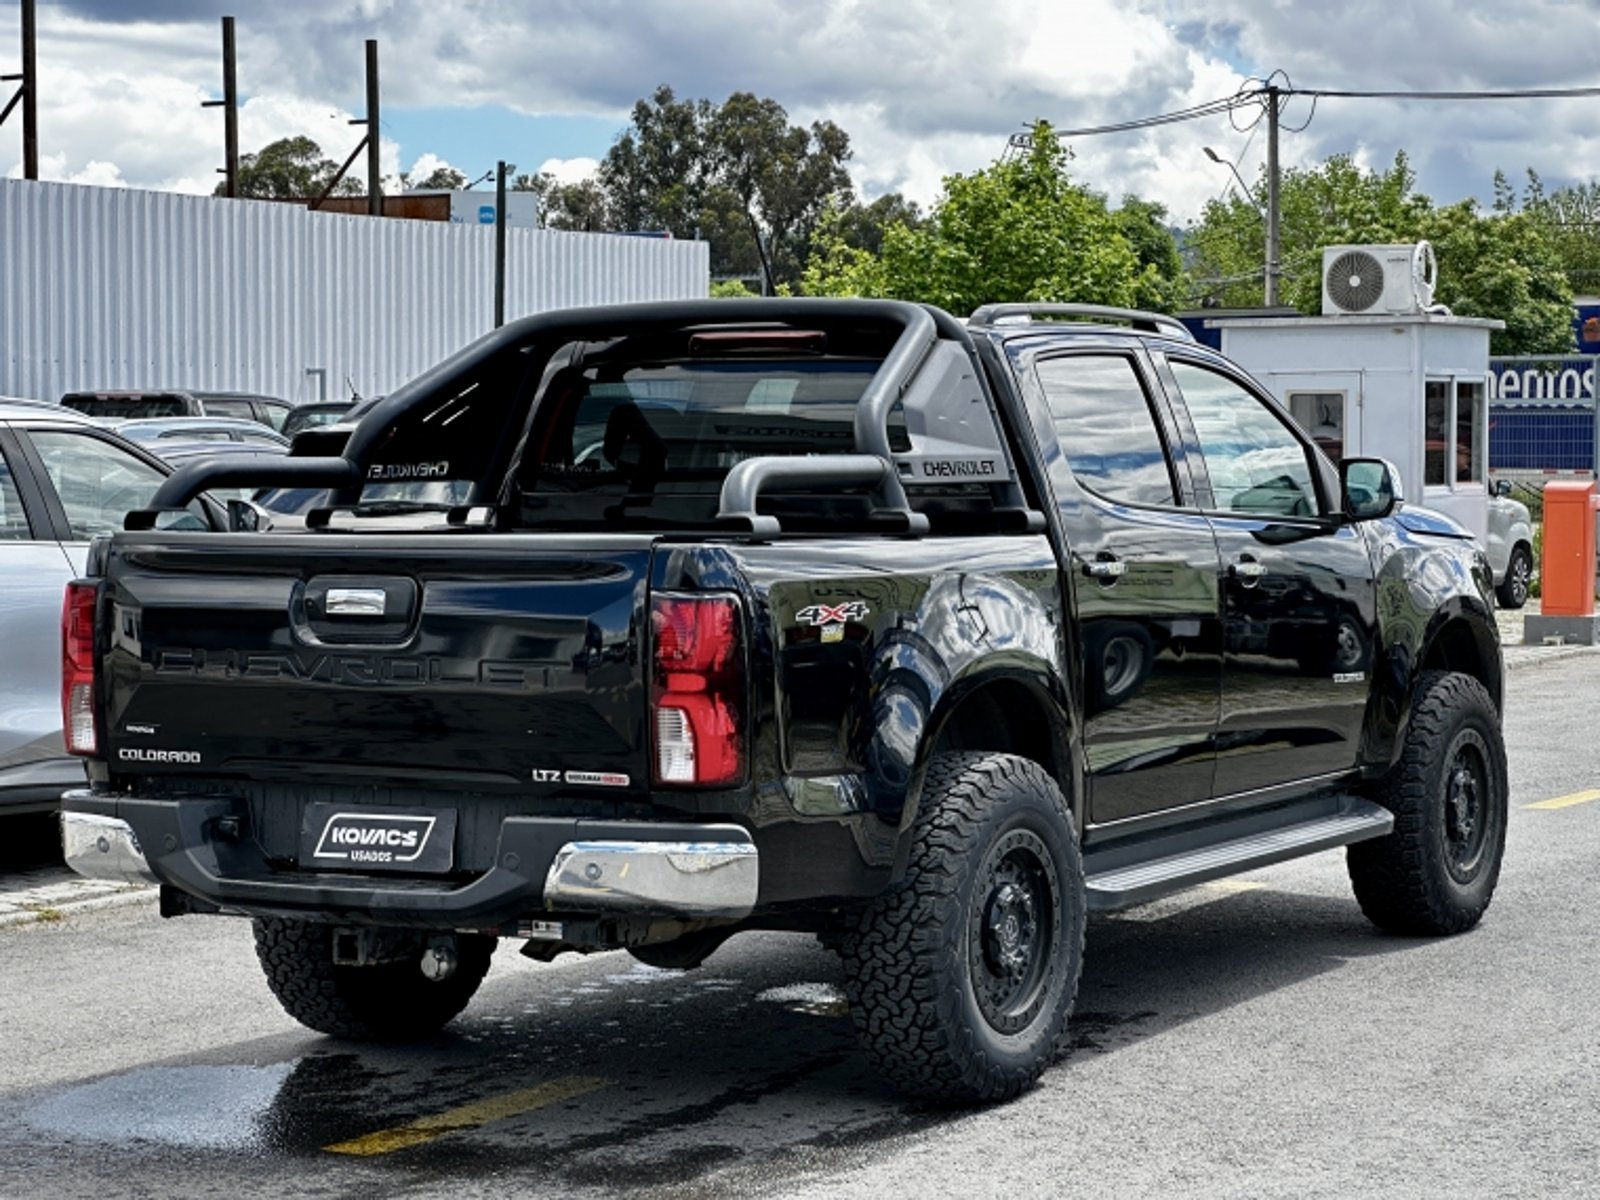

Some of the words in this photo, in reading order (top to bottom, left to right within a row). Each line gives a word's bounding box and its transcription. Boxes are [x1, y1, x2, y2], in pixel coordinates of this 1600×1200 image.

[922, 461, 995, 477] CHEVROLET
[118, 748, 201, 764] COLORADO
[532, 768, 561, 783] LTZ
[331, 826, 418, 847] KOVACS
[351, 850, 392, 862] USADOS
